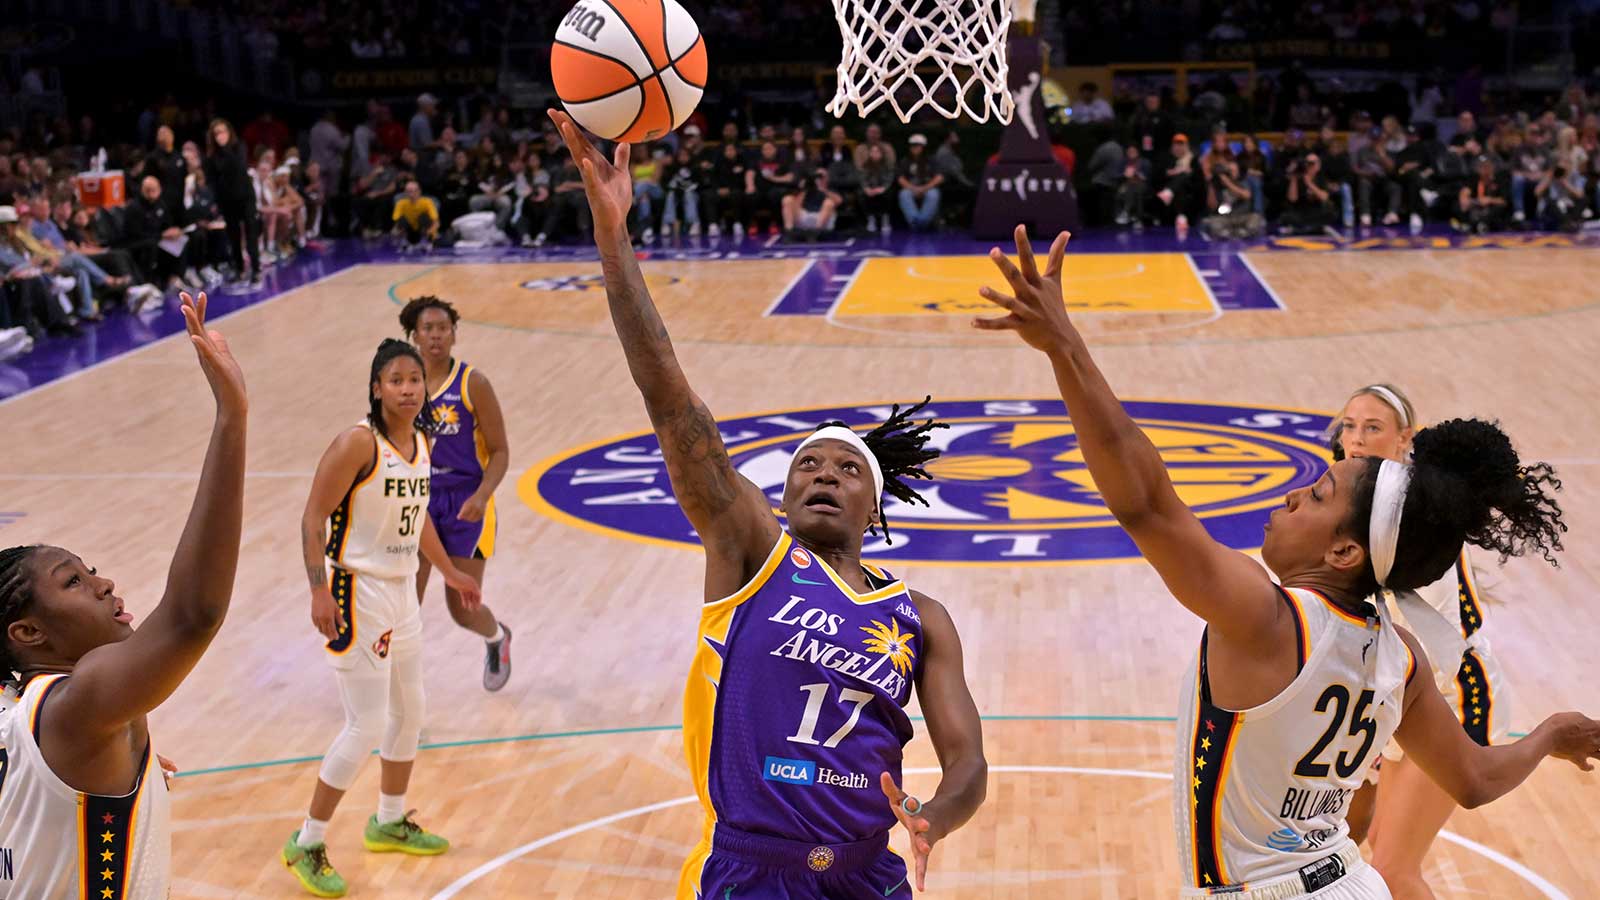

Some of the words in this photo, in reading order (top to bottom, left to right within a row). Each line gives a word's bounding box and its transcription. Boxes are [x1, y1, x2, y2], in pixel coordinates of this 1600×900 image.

[768, 595, 845, 635] LOS
[770, 630, 906, 699] ANGELES
[786, 683, 875, 748] 17
[1293, 683, 1385, 779] 25
[769, 763, 808, 781] UCLA
[817, 767, 868, 788] Health
[1280, 787, 1351, 820] BILLINGS
